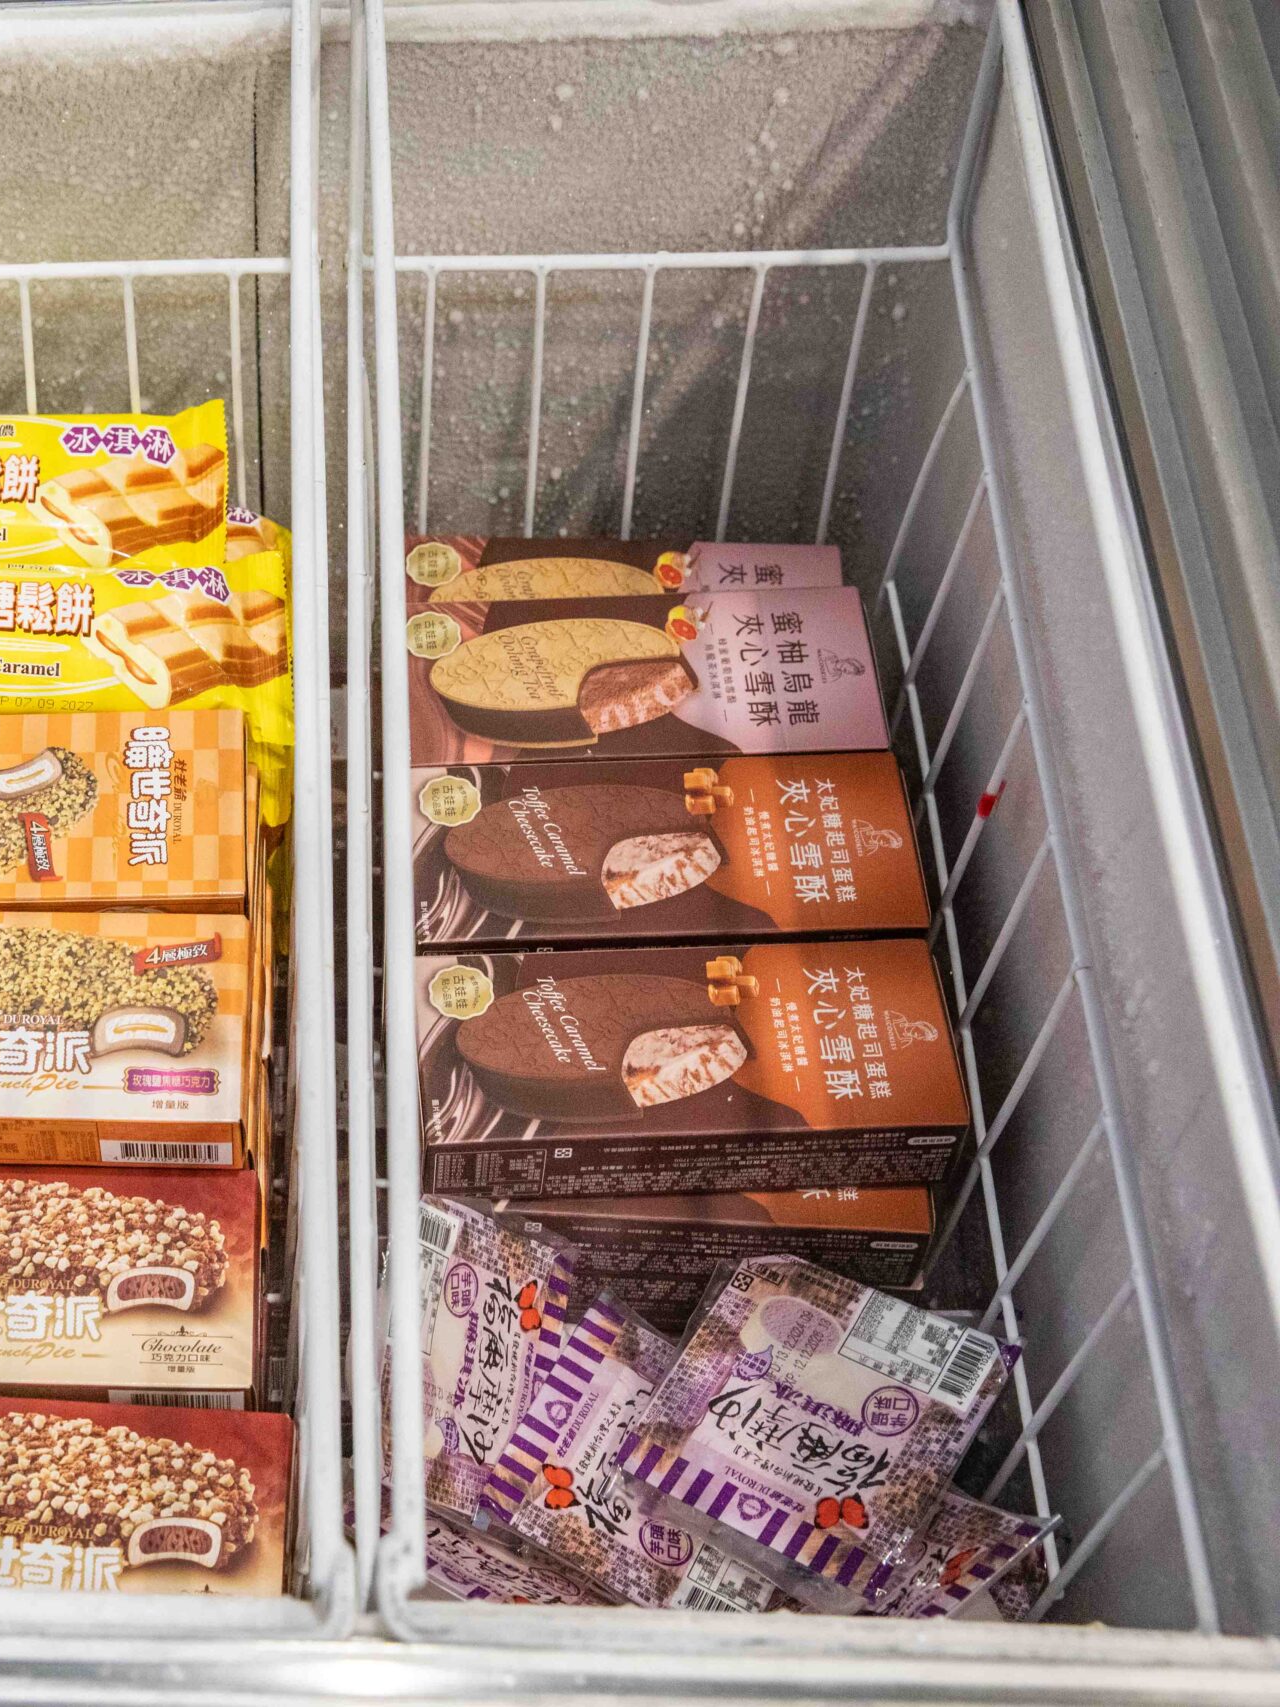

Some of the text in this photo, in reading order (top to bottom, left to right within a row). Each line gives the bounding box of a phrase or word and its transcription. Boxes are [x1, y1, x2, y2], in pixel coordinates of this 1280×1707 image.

[66, 427, 176, 464] 冰淇淋
[121, 567, 230, 604] 冰淇淋
[732, 613, 782, 728] 夾心雪酥
[771, 611, 821, 726] 蜜柚烏龍
[124, 726, 175, 866] 曠世奇派
[173, 801, 187, 845] DUROYAL
[29, 821, 50, 871] 4層極致
[507, 799, 557, 869] Cheesecake
[522, 785, 588, 876] Toffee Caramel
[743, 805, 765, 878] 奶油起司冰淇淋
[775, 778, 831, 904] 夾心雪酥
[815, 777, 858, 904] 太妃糖起司蛋糕
[145, 943, 208, 965] 4層極致
[4, 1013, 64, 1026] DUROYAL
[452, 974, 469, 1010] 古娃娃
[536, 975, 607, 1073] Toffee Caramel
[521, 990, 572, 1064] Cheesecake
[770, 996, 795, 1073] 奶油起司冰淇淋
[785, 1000, 809, 1067] 慢煮太妃糖醬
[802, 967, 864, 1100] 夾心雪酥
[843, 965, 893, 1100] 太妃糖起司蛋糕
[13, 1278, 74, 1291] DUROYAL
[140, 1337, 223, 1355] Chocolate
[150, 1353, 212, 1364] 巧克力口味
[573, 1391, 600, 1436] DUROYAL
[723, 1463, 773, 1496] DUROYAL
[29, 1524, 94, 1541] DUROYAL
